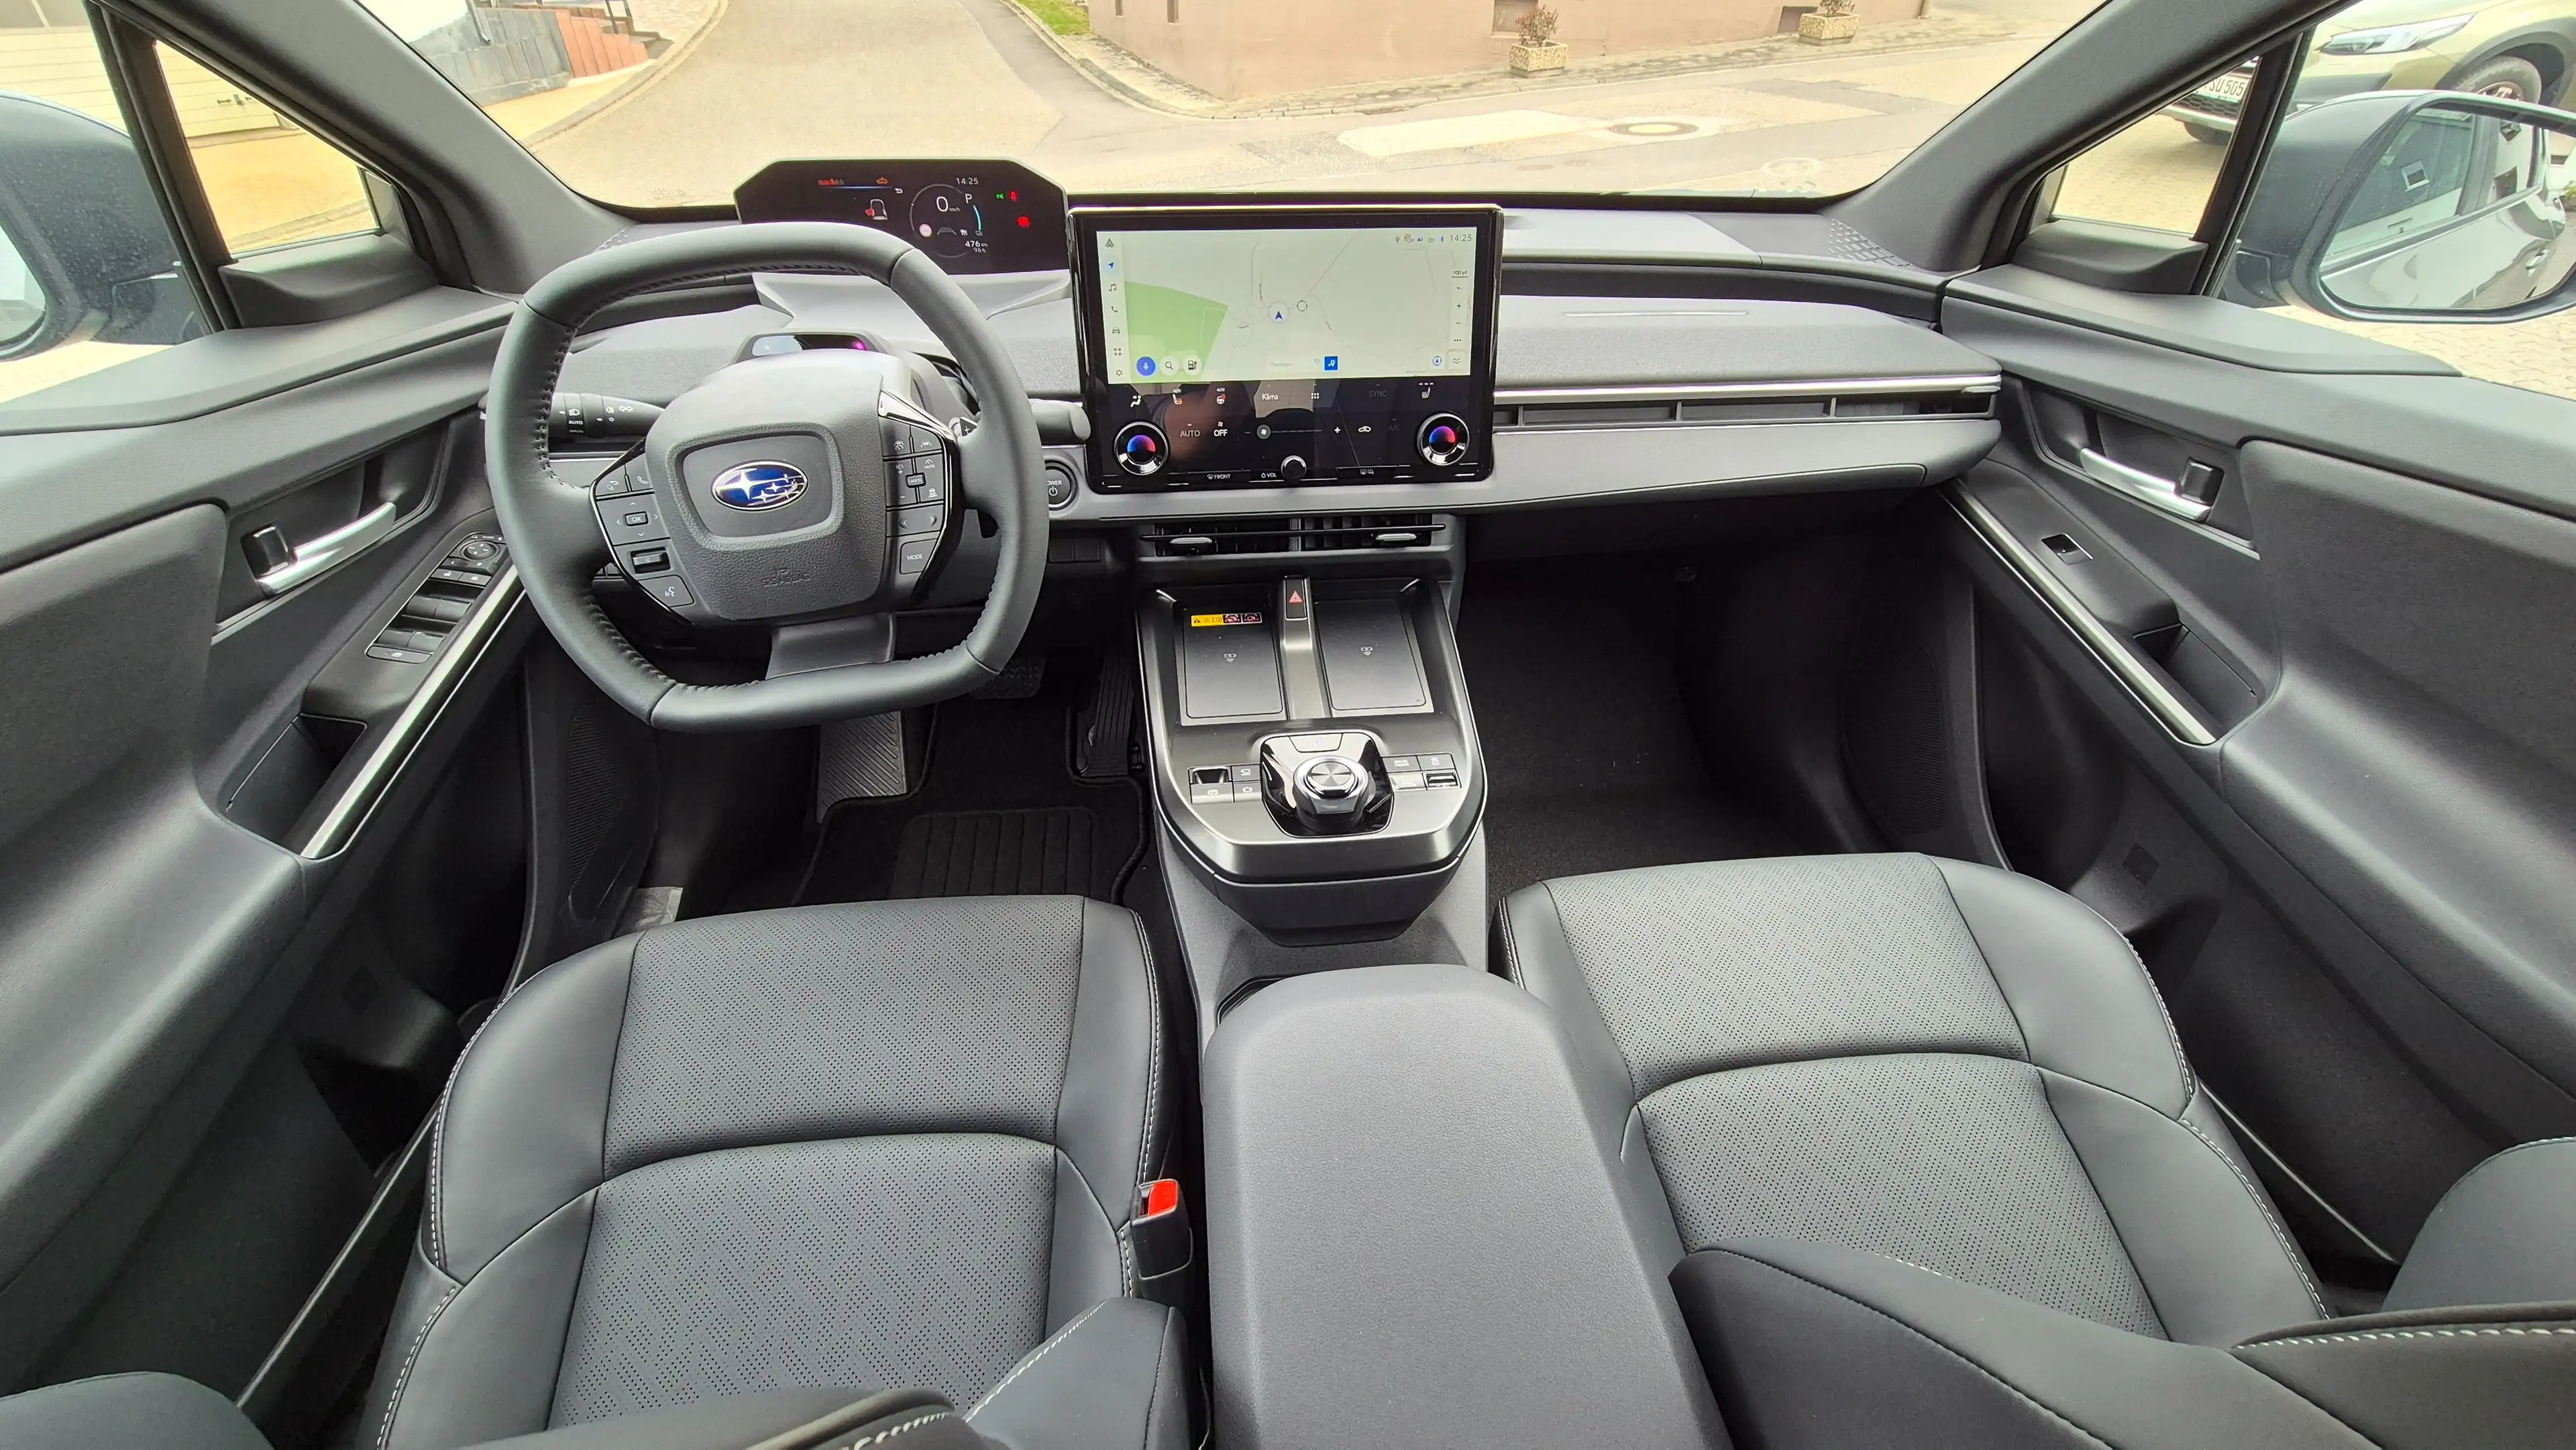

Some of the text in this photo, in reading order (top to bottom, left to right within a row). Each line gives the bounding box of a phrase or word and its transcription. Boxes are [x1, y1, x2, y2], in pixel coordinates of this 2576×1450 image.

[2224, 80, 2246, 97] 505
[965, 193, 973, 204] P
[936, 196, 949, 212] 0
[1450, 234, 1472, 242] 14:25
[1262, 393, 1279, 401] Klima
[1368, 390, 1388, 398] SYNC
[1180, 429, 1201, 437] AUTO
[1214, 429, 1228, 437] OFF
[906, 553, 923, 561] MODE
